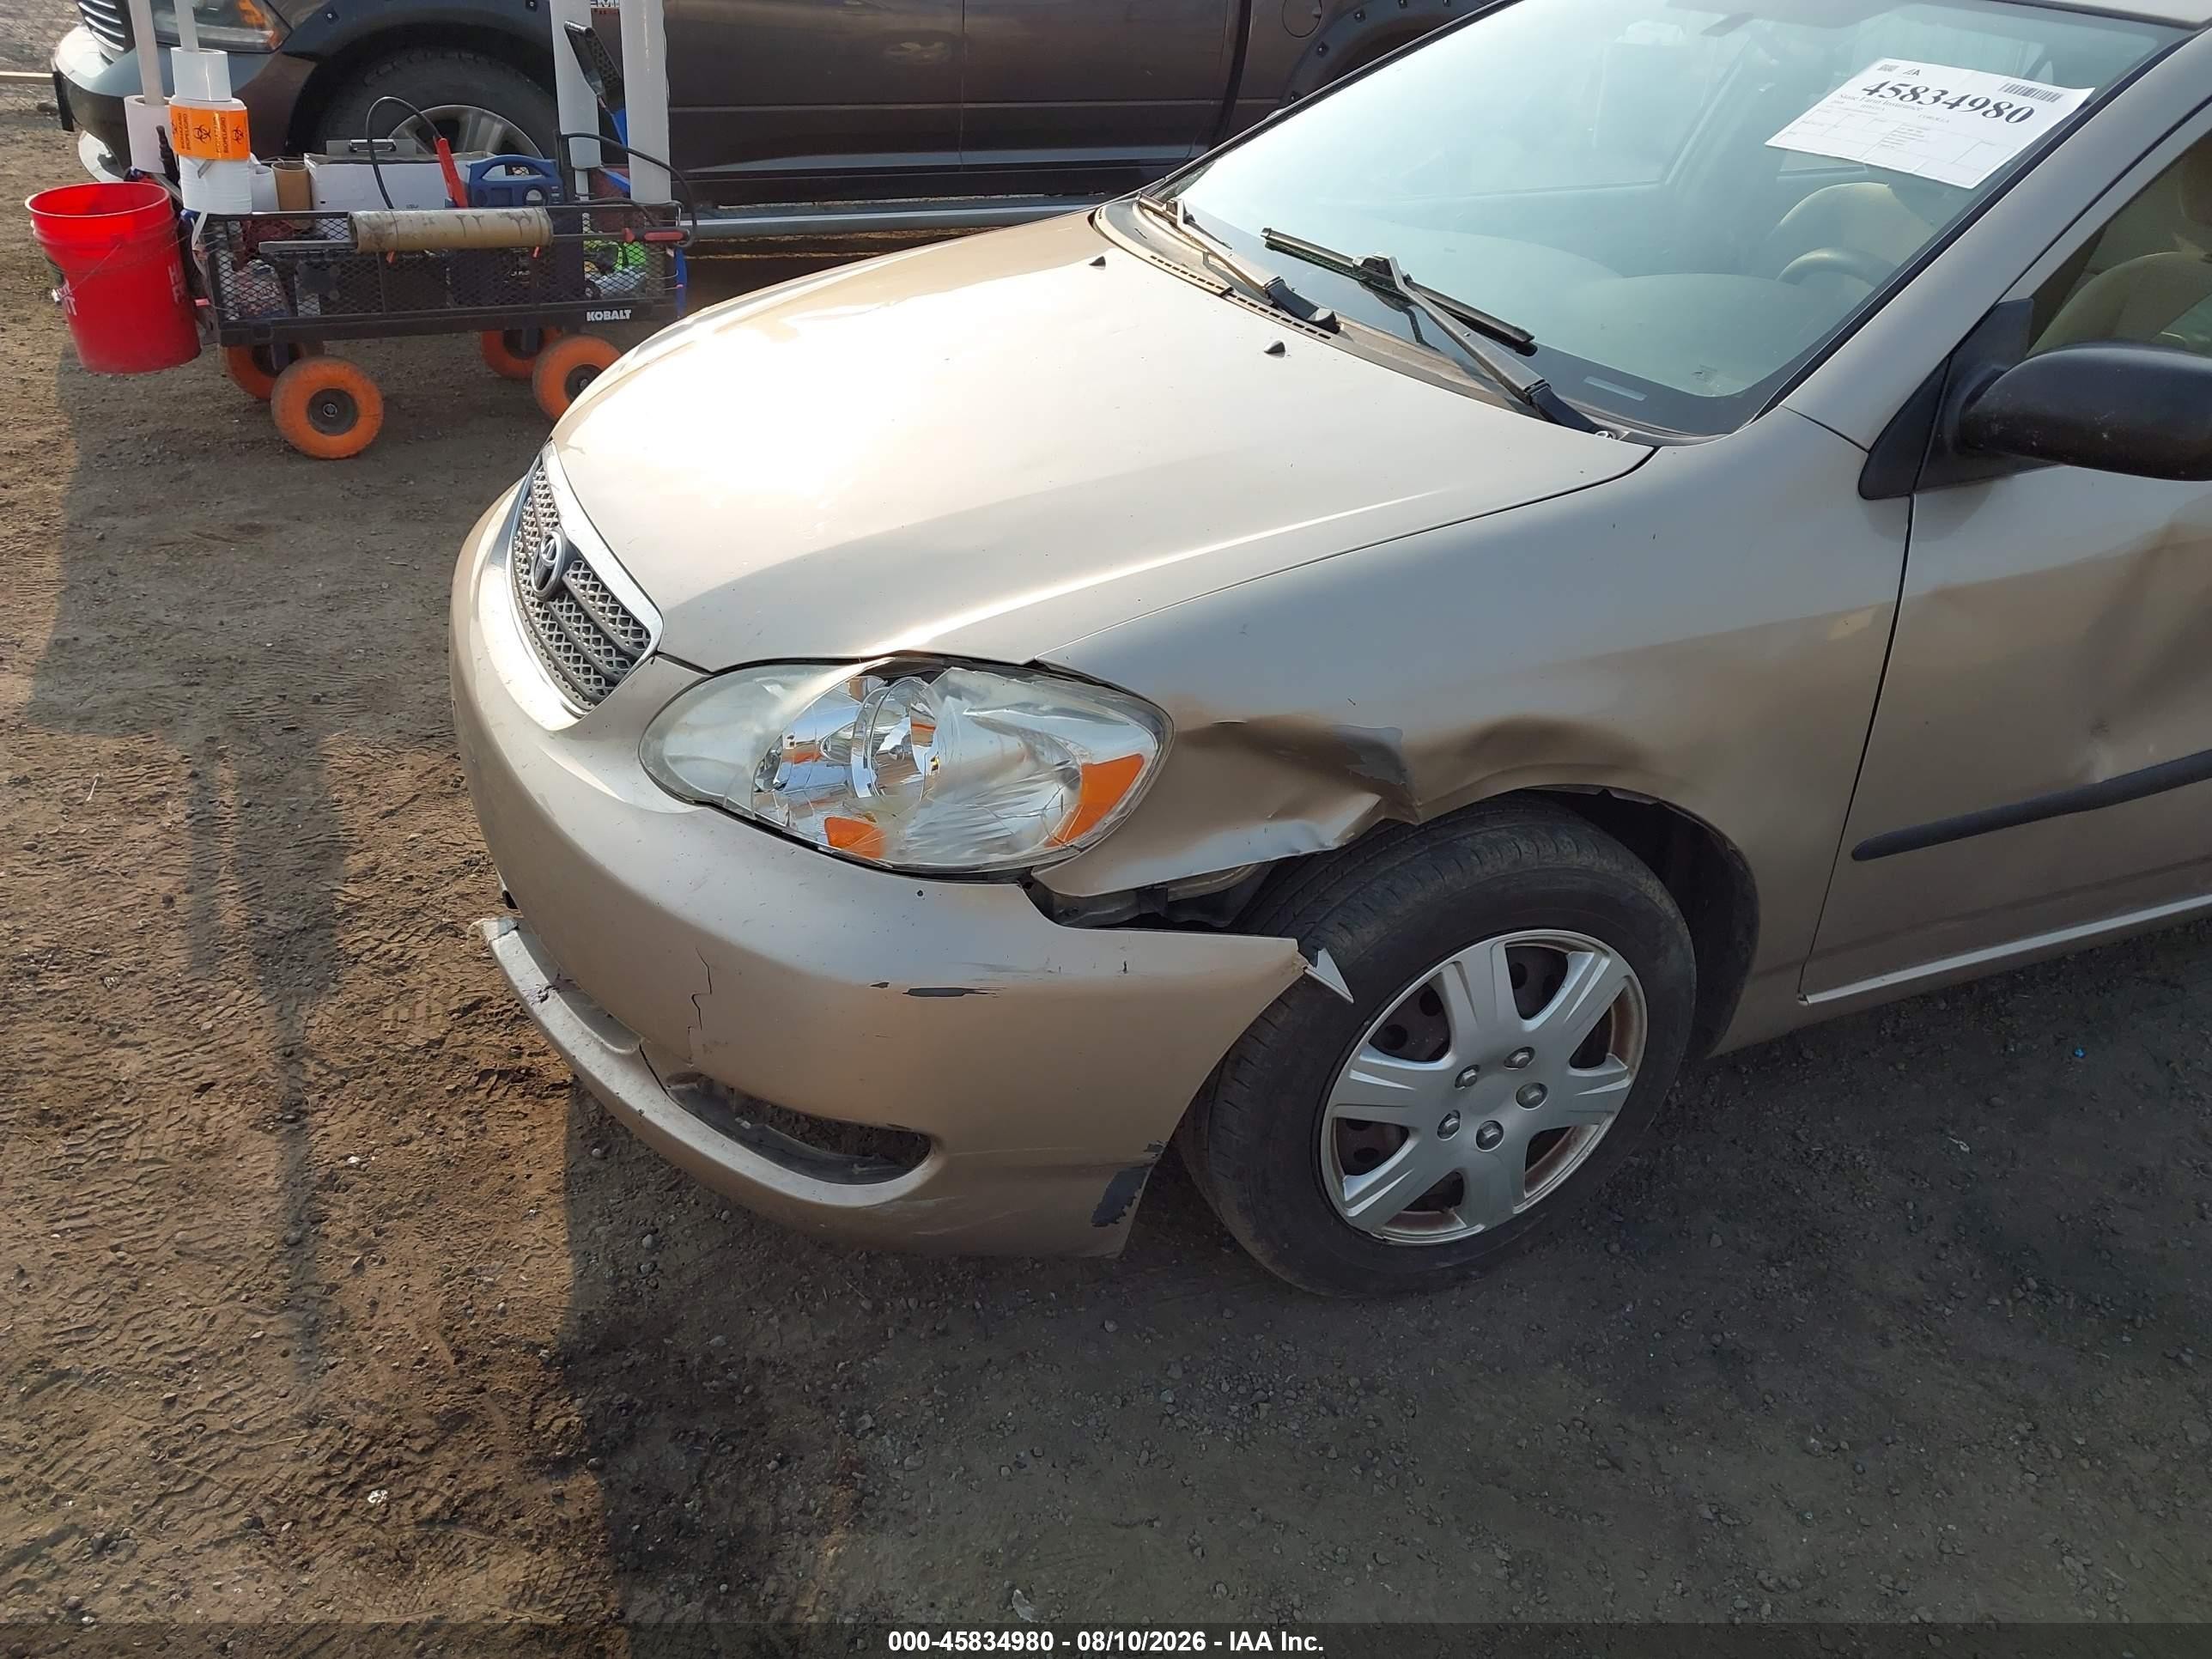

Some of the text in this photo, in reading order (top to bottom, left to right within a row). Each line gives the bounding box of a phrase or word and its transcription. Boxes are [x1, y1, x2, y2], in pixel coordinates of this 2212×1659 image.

[1859, 95, 1882, 105] Farm
[1882, 99, 1924, 112] Insurance
[1862, 80, 2035, 124] 45834980
[183, 113, 191, 150] BIOPELIGRO
[586, 309, 632, 321] KOBALT
